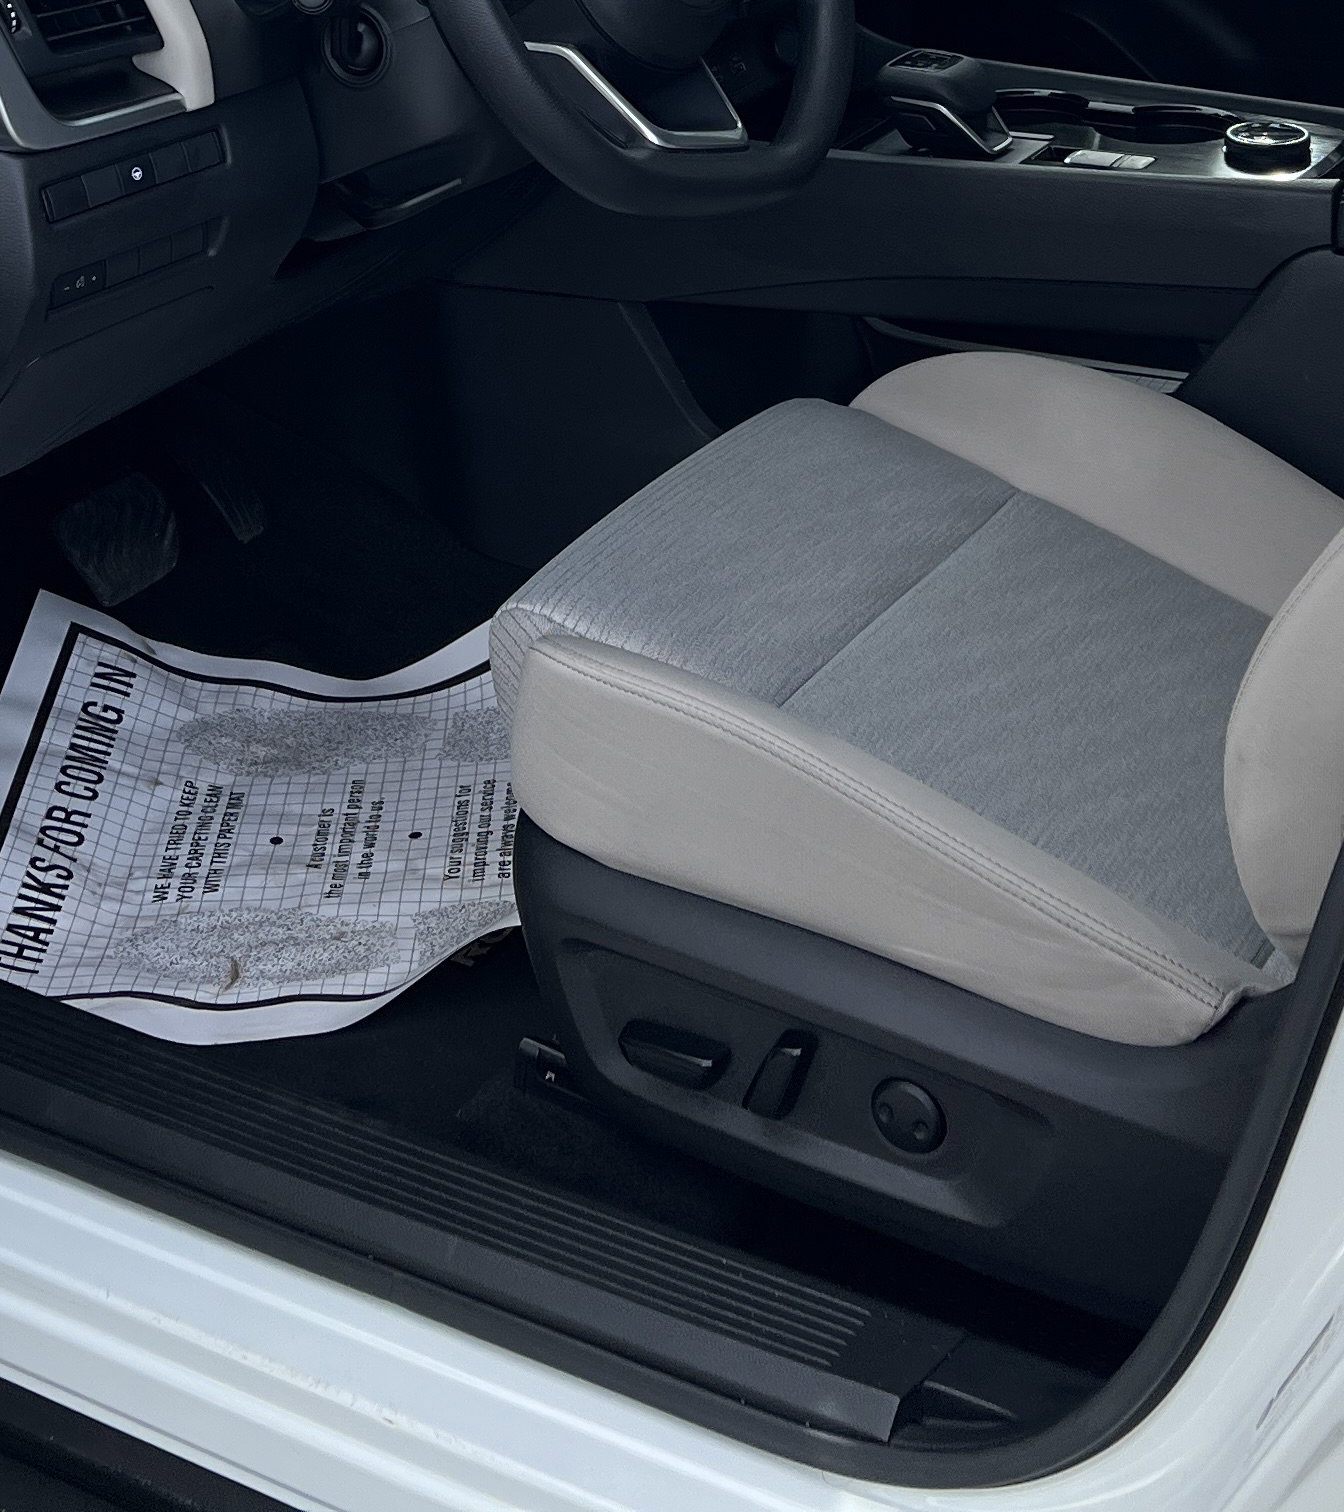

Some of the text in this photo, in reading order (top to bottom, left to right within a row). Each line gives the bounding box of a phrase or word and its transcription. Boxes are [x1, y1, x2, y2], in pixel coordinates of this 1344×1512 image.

[90, 661, 137, 698] IN
[54, 701, 125, 801] COMING
[318, 808, 334, 817] is
[365, 814, 382, 823] to
[443, 785, 471, 881] Your suggestions for
[468, 779, 496, 882] improving our service
[36, 805, 92, 863] FOR
[152, 780, 199, 903] WE HAVE TRIED TO KEEP
[176, 784, 223, 902] YOUR CARPETING CLEAN
[202, 791, 245, 894] WITH THIS PAPER MAT
[311, 820, 332, 861] customer
[323, 780, 365, 898] the most important person
[363, 825, 379, 849] world
[496, 823, 515, 857] always
[354, 871, 371, 879] in
[357, 852, 374, 868] the
[498, 860, 511, 878] are
